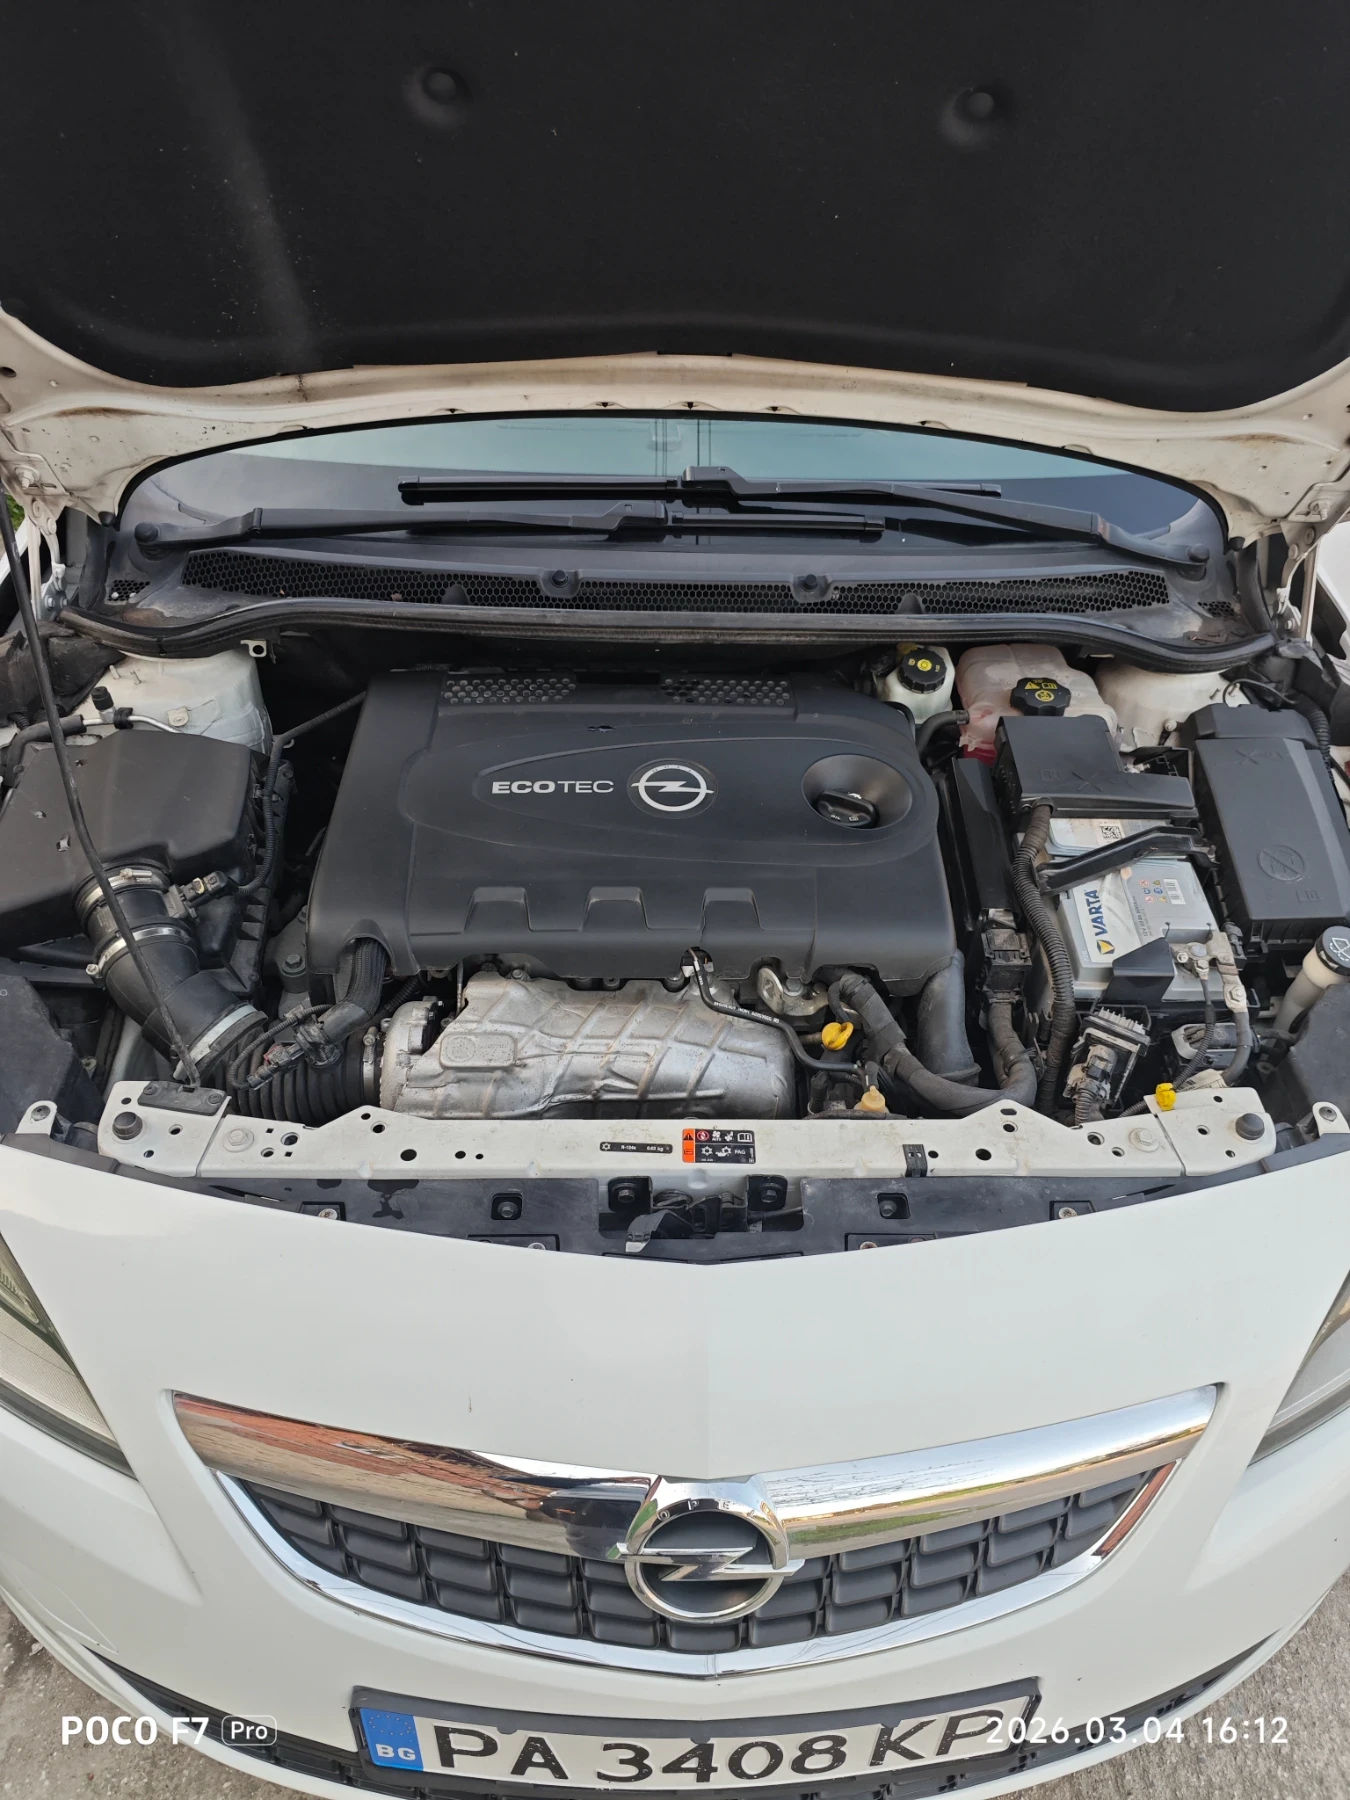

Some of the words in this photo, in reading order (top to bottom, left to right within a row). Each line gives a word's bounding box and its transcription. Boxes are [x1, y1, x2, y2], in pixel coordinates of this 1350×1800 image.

[492, 780, 614, 794] ECOTEC
[1084, 889, 1108, 937] VARTA
[375, 1743, 417, 1761] BG
[433, 1725, 569, 1780] PA
[597, 1734, 848, 1784] 3408
[869, 1709, 1005, 1767] KP
